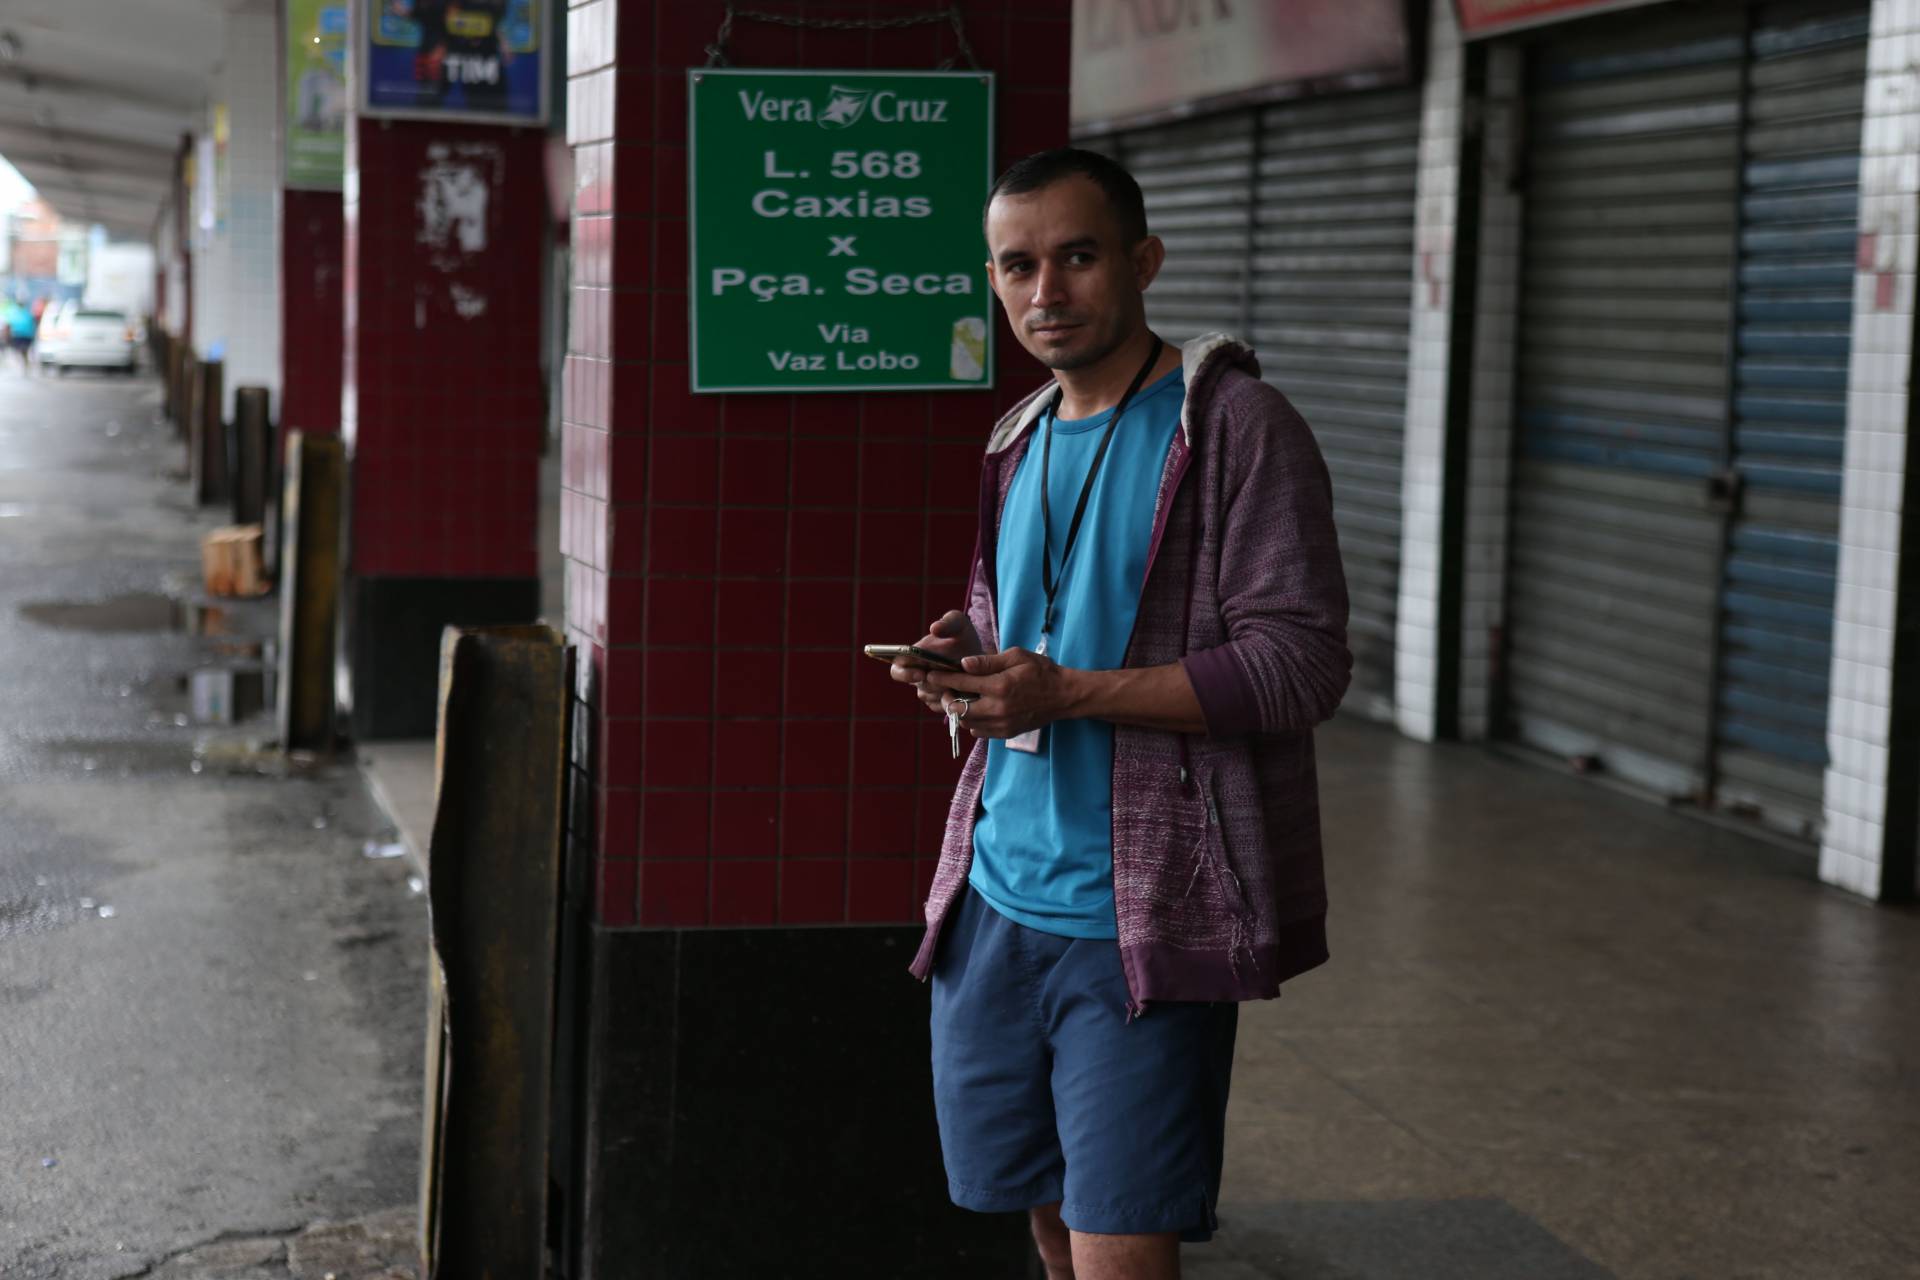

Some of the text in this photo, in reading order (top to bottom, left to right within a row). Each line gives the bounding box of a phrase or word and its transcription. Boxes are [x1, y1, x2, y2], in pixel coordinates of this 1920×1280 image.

[443, 54, 499, 85] TIM
[739, 91, 948, 122] Vera Cruz
[764, 151, 922, 178] L. 568
[752, 189, 932, 218] Caxias
[712, 267, 973, 302] Pça. Seca
[817, 323, 869, 343] Via
[767, 350, 919, 371] Vaz Lobo
